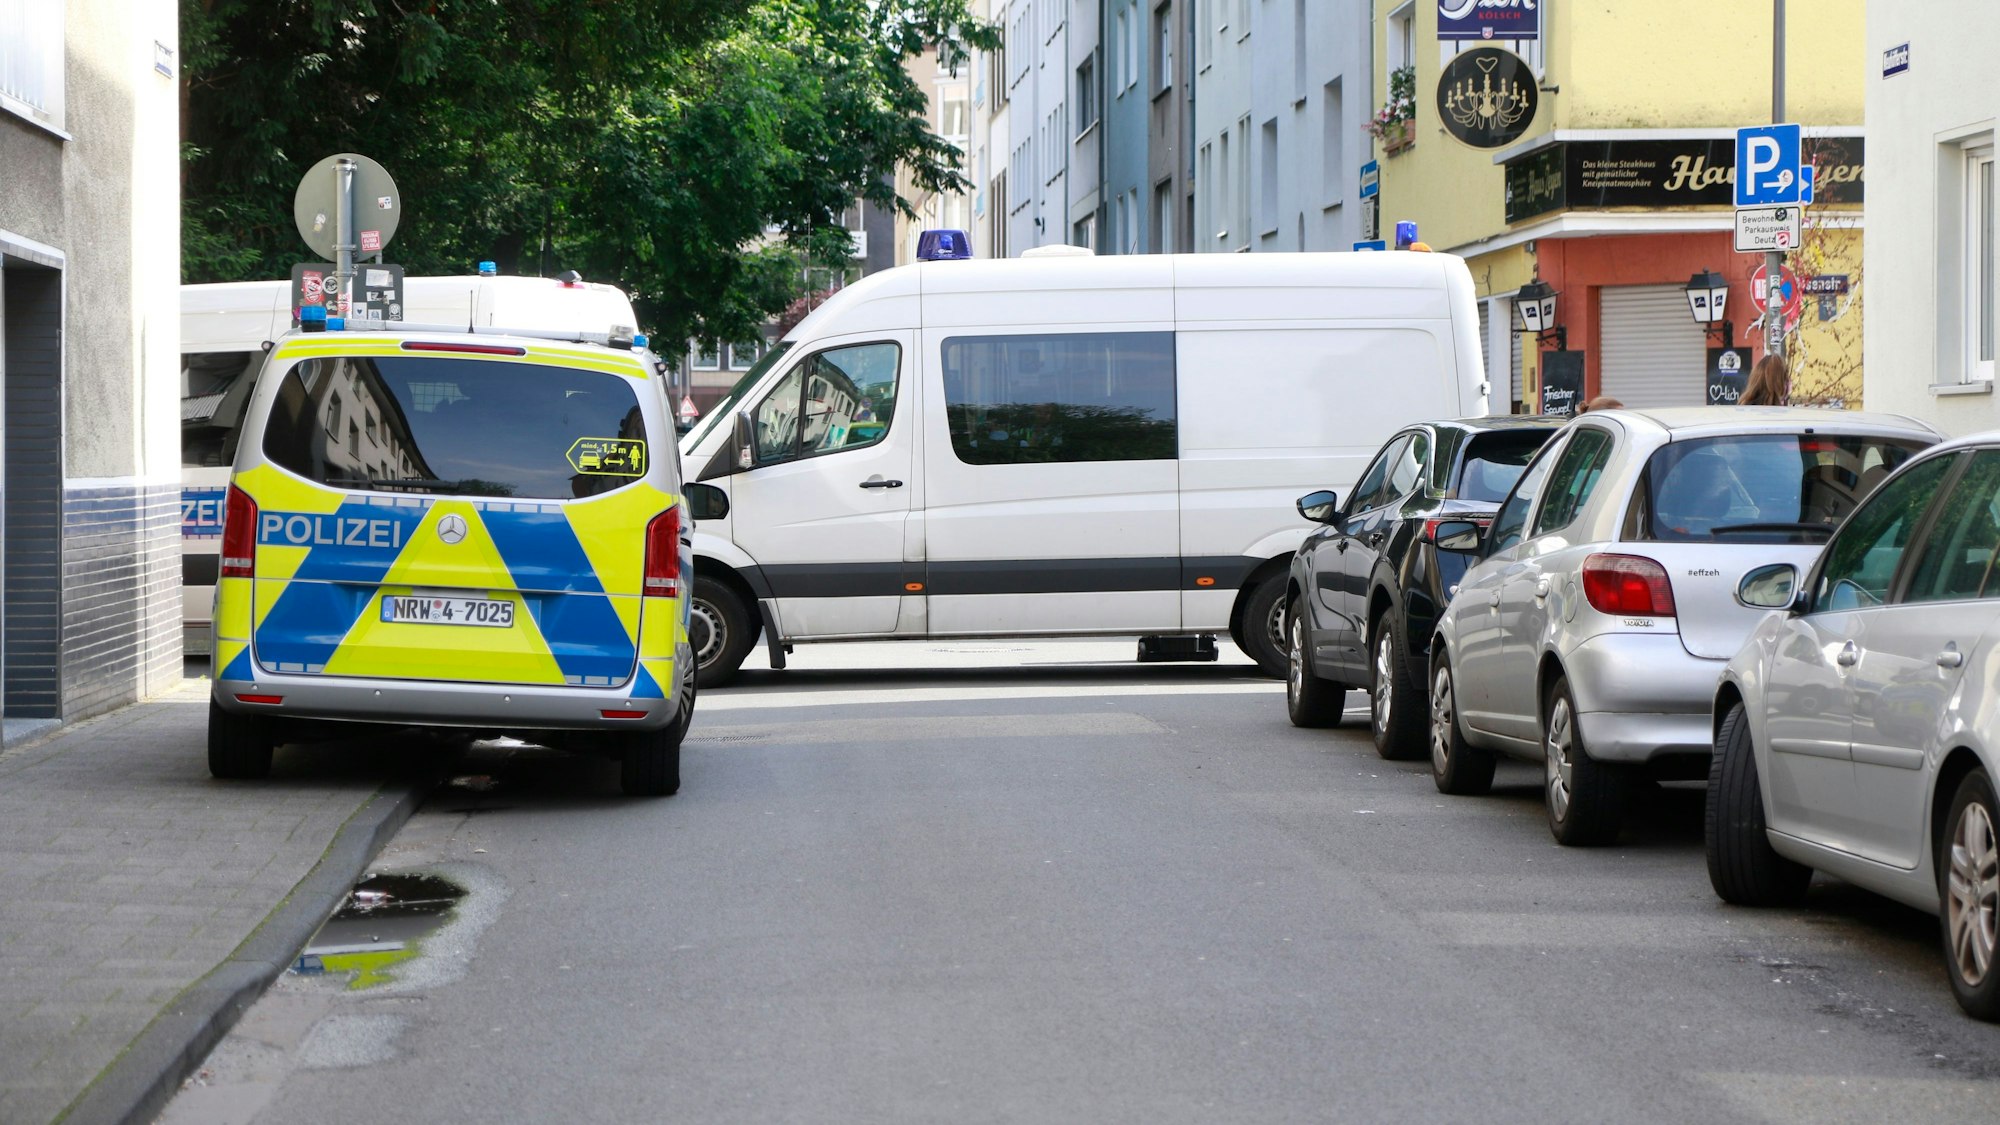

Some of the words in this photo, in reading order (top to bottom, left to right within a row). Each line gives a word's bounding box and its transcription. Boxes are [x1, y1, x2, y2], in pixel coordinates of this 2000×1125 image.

[1582, 160, 1596, 169] Das
[1597, 160, 1619, 168] kleine
[1619, 160, 1656, 168] Steakhaus
[1746, 136, 1780, 196] P
[1582, 170, 1595, 178] mit
[1595, 170, 1638, 179] gemütlicher
[1663, 155, 1735, 191] Ha
[1582, 179, 1651, 188] Kneipenatmosphäre
[1745, 225, 1790, 234] Parkausweis
[1544, 385, 1575, 402] Frischer
[602, 443, 618, 454] 1,5
[181, 499, 224, 527] ZEI
[261, 514, 401, 548] POLIZEI
[1688, 569, 1720, 577] #effzeh
[393, 598, 431, 619] NRW
[1624, 619, 1655, 627] TOYOTA
